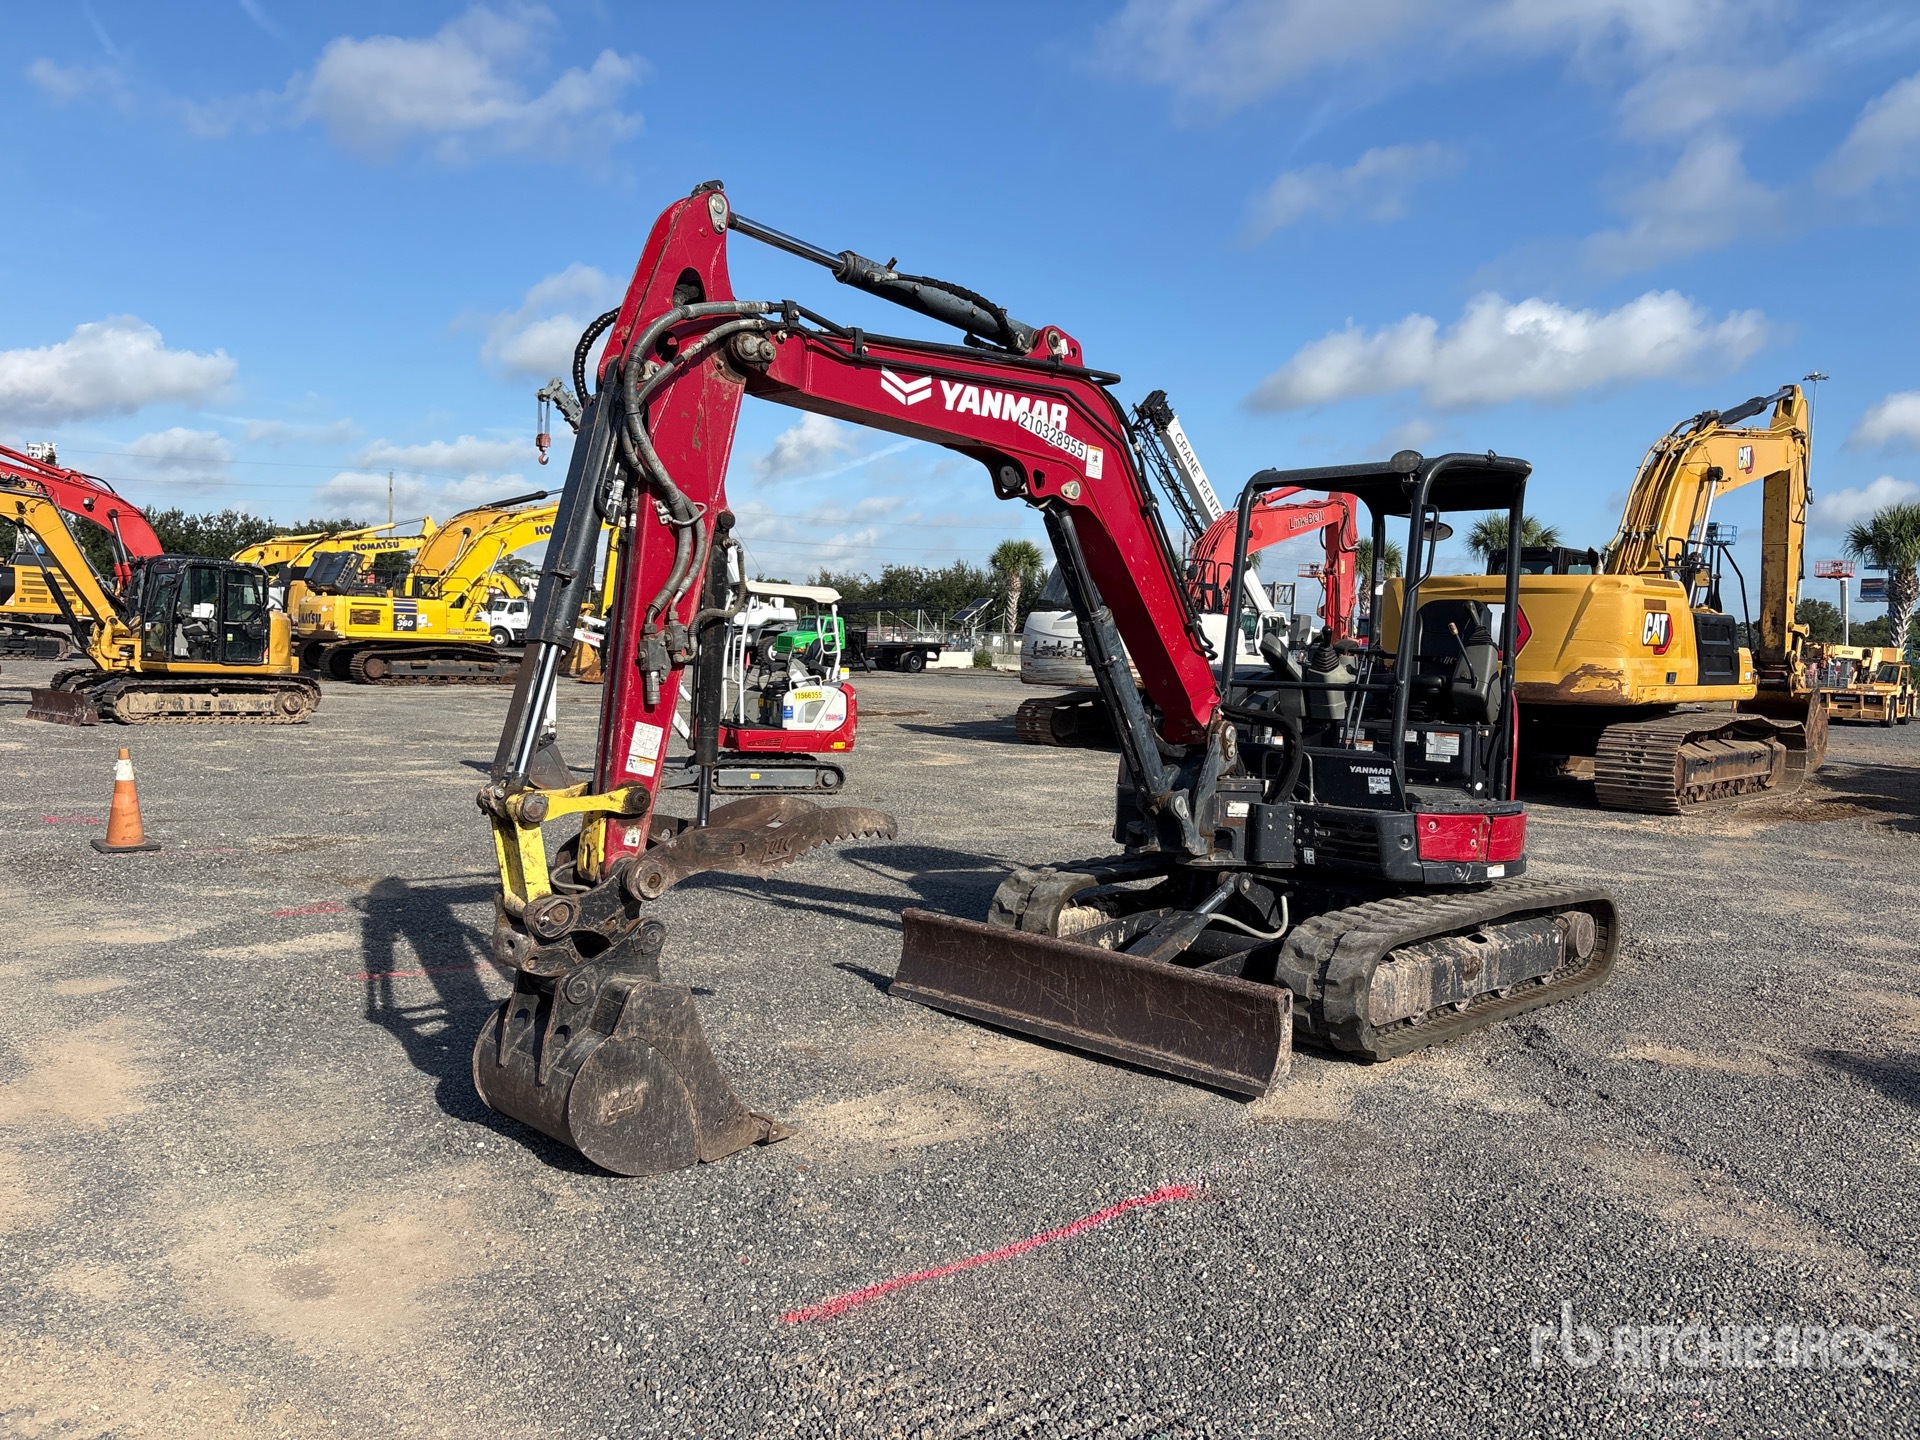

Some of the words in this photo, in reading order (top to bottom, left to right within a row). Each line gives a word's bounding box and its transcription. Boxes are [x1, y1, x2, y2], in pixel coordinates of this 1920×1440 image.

[939, 380, 1069, 431] YANMAR
[1021, 411, 1084, 458] 210328955
[1175, 432, 1201, 478] CRANE
[1738, 446, 1752, 469] CAT
[1289, 510, 1325, 530] Link-Belt
[352, 540, 400, 551] KOMATSU
[397, 619, 414, 628] 360
[1642, 612, 1668, 645] CAT
[1349, 765, 1392, 776] YANMAR
